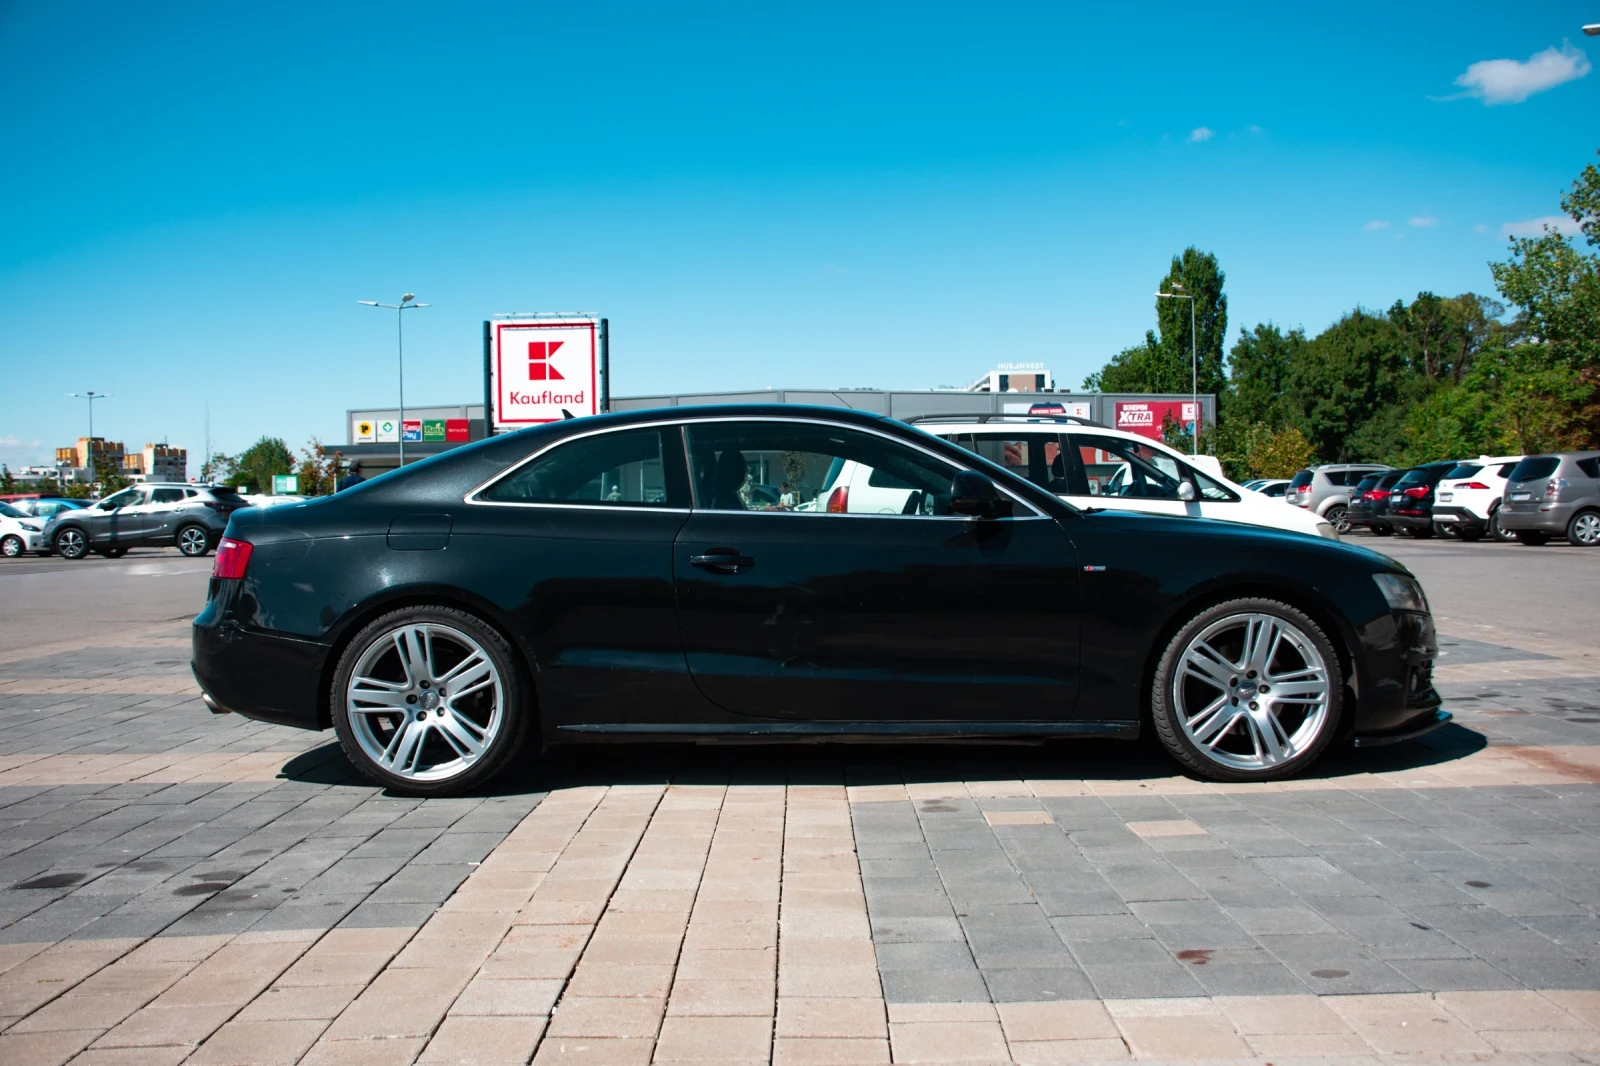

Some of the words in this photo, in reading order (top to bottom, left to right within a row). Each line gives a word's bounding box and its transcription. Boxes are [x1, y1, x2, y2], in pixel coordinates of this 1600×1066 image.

[1017, 362, 1044, 370] INVEST
[509, 390, 584, 405] Kaufland
[1118, 411, 1152, 423] XTRA
[402, 423, 421, 432] Easy
[402, 431, 417, 440] Pay
